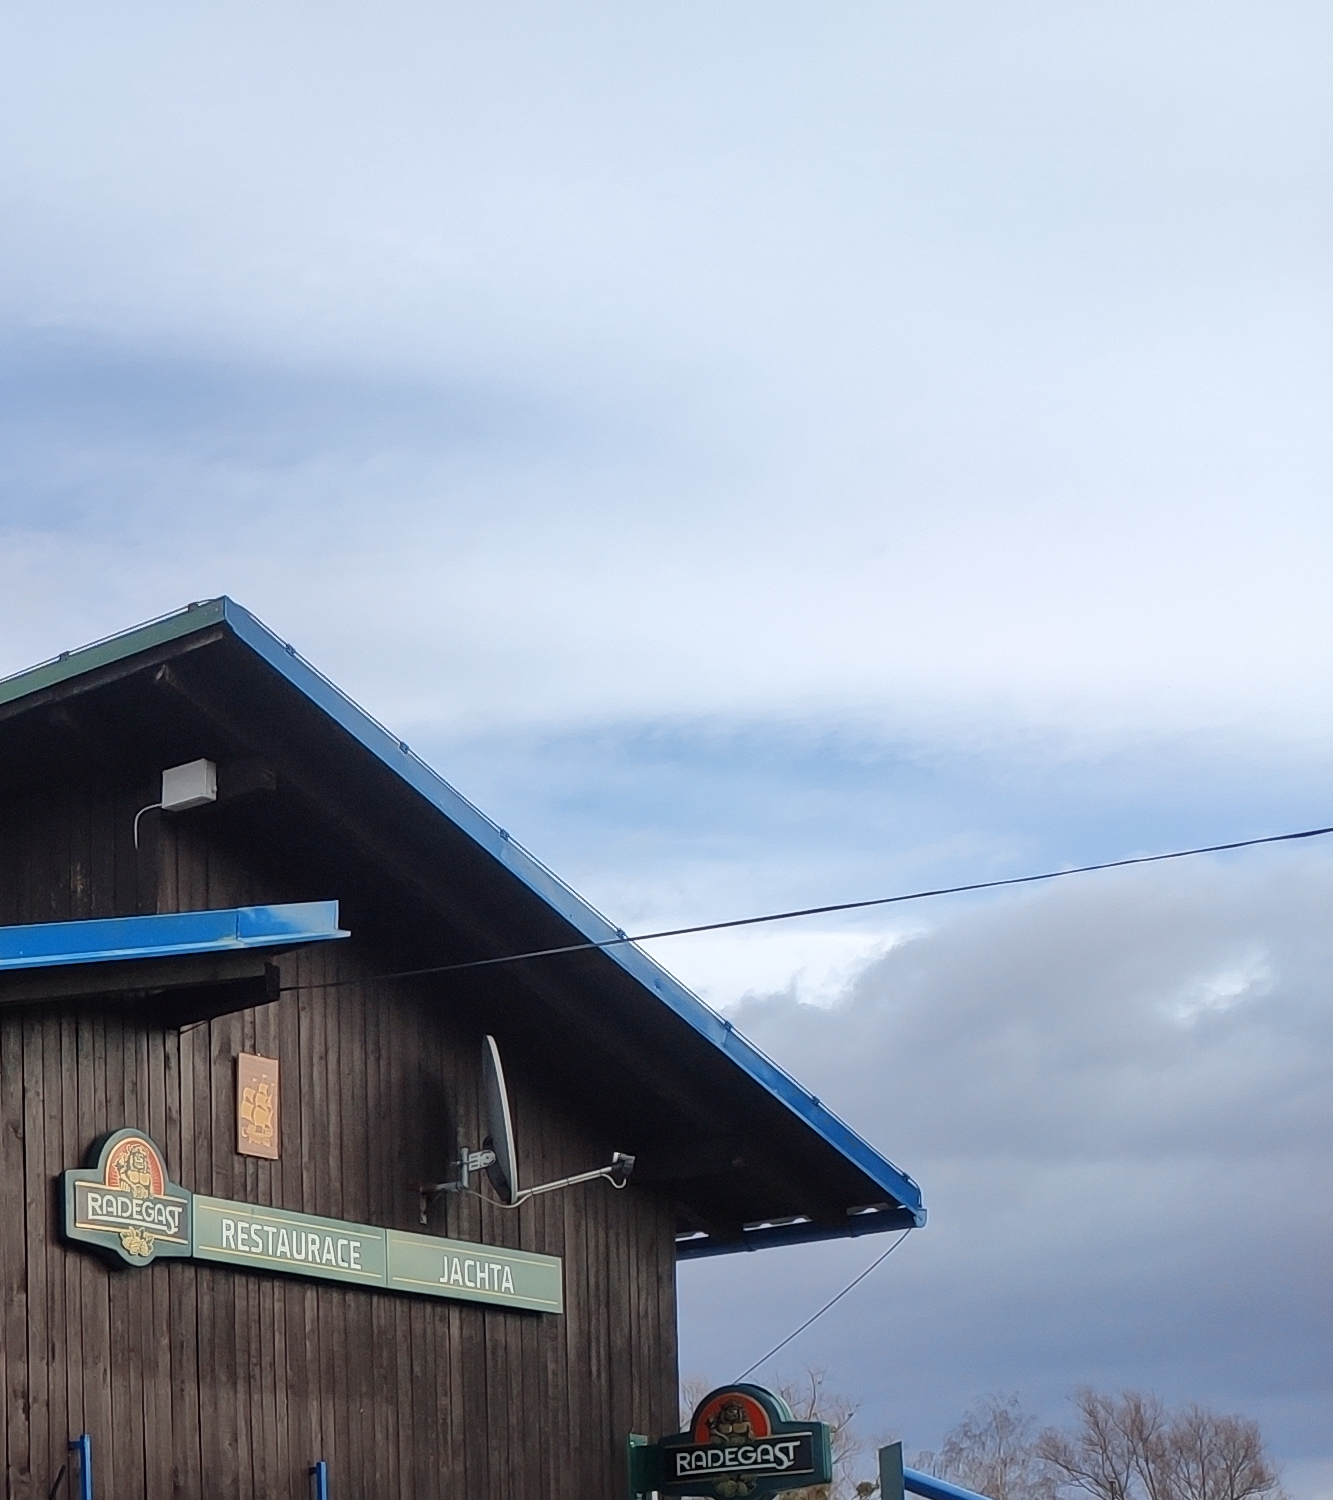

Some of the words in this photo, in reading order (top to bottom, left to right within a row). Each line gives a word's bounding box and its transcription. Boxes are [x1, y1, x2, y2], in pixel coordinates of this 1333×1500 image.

[87, 1192, 183, 1234] RADEGAST
[221, 1218, 362, 1271] RESTAURACE
[439, 1254, 515, 1295] JACHTA
[676, 1440, 801, 1477] RADEGAST
